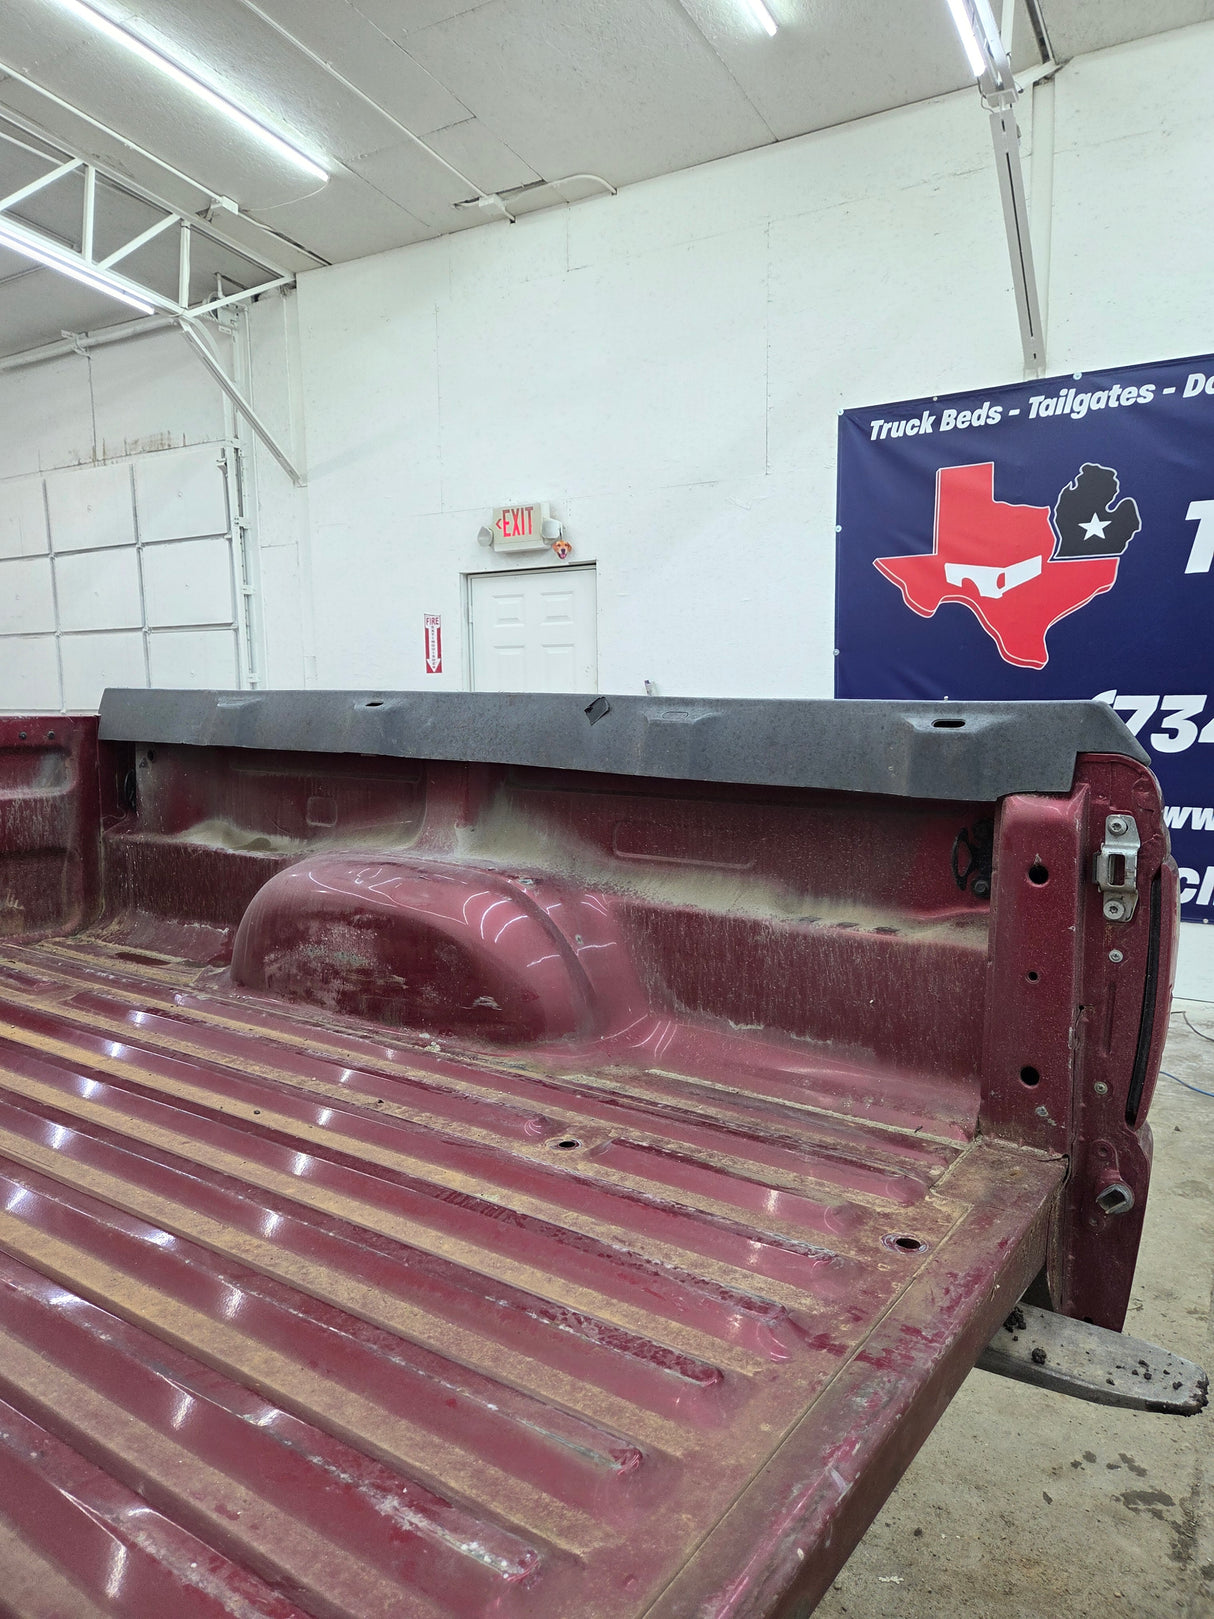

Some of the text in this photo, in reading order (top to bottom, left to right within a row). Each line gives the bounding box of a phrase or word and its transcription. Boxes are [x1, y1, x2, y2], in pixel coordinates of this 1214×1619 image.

[870, 410, 936, 441] Truck
[939, 401, 1003, 432] Beds
[1028, 383, 1156, 420] Tailgates
[502, 506, 534, 538] EXIT
[425, 617, 439, 626] FIRE
[1091, 689, 1214, 753] 73
